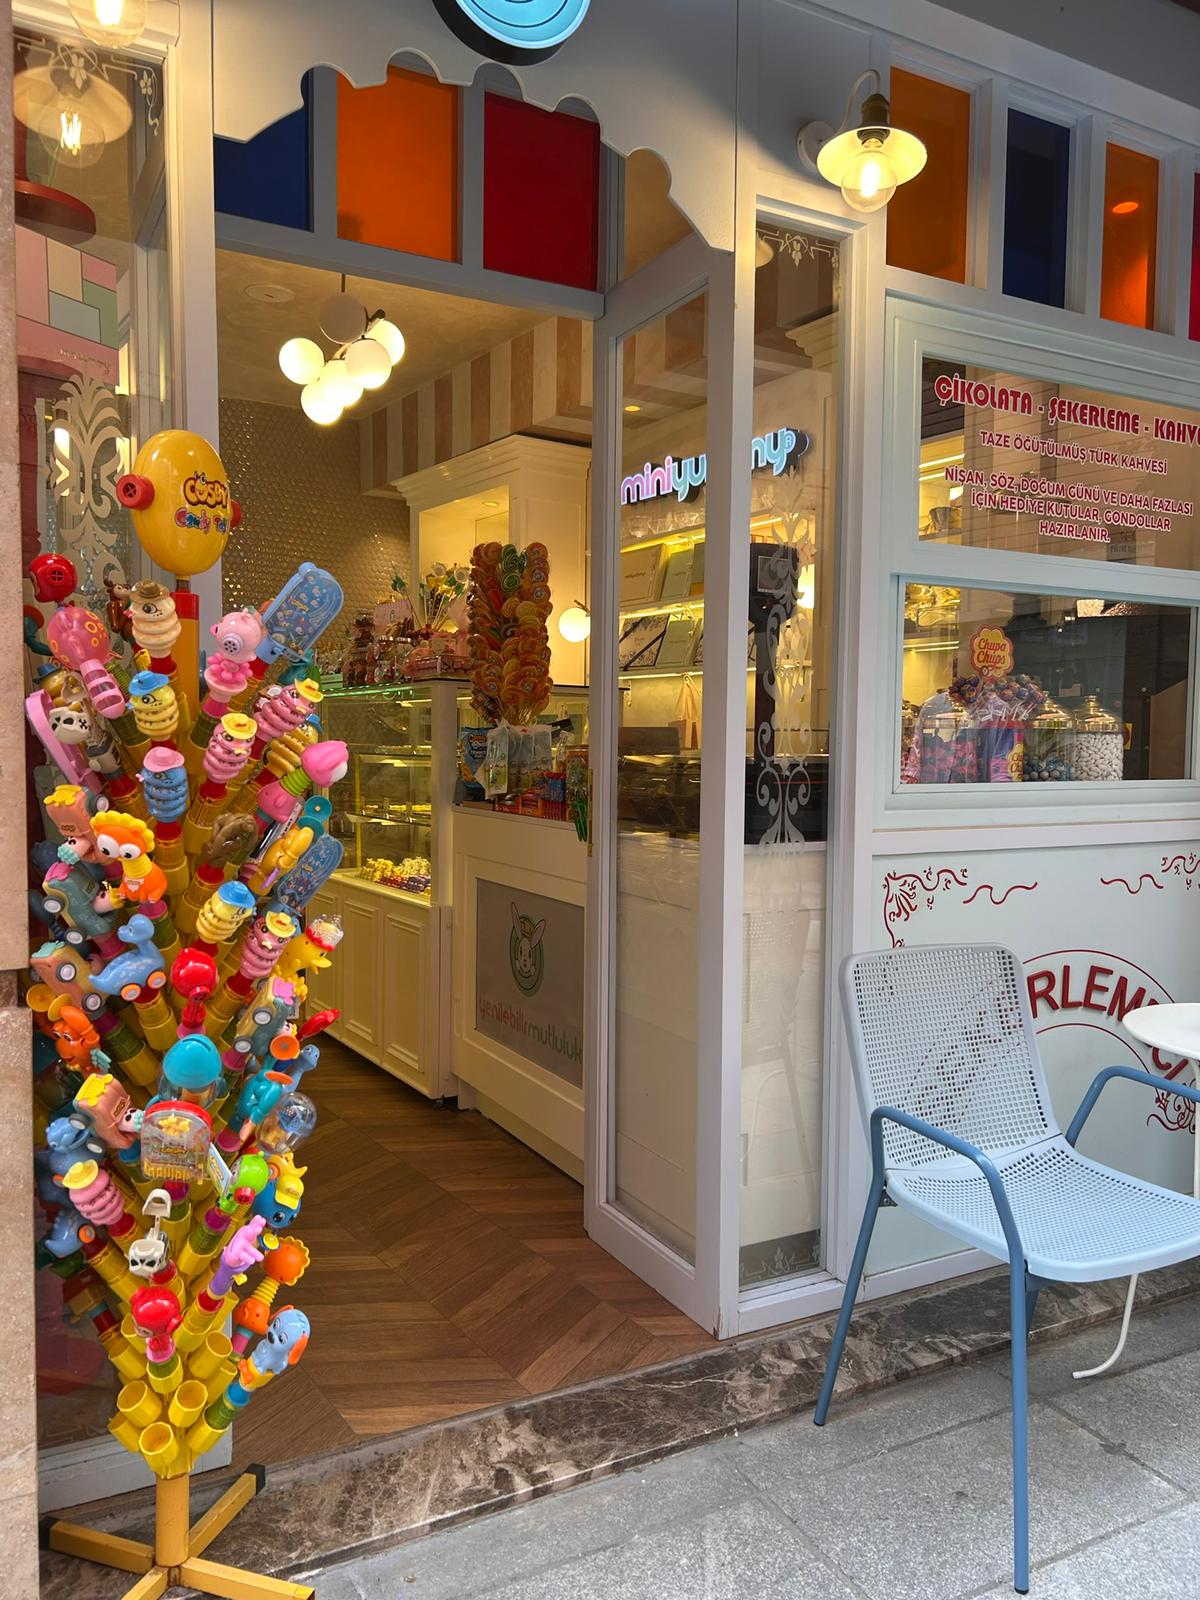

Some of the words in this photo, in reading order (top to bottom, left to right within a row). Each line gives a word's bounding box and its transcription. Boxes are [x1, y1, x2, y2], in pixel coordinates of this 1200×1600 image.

[935, 373, 1033, 416] ÇİKOLATA
[1048, 397, 1140, 434] ŞEKERLEME
[980, 431, 1011, 448] TAZE
[1014, 434, 1086, 464] ÖĞÜTÜLMÜŞ
[1089, 447, 1118, 466] TÜRK
[1121, 454, 1167, 474] KAHVESİ
[945, 466, 987, 488] NİŞAN,
[990, 472, 1018, 492] SÖZ,
[1021, 478, 1065, 497] DOĞUM
[1068, 484, 1100, 502] GÜNÜ
[1103, 490, 1118, 504] VE
[1120, 493, 1150, 509] DAHA
[1152, 498, 1193, 515] FAZLASI
[972, 489, 997, 510] İÇİN
[1000, 496, 1044, 513] HEDİYE
[1047, 502, 1102, 523] KUTULAR,
[1104, 510, 1171, 530] GONDOLLAR
[1039, 521, 1110, 542] HAZIRLANIR.
[977, 650, 1006, 666] Chups
[978, 638, 1006, 653] Chupa
